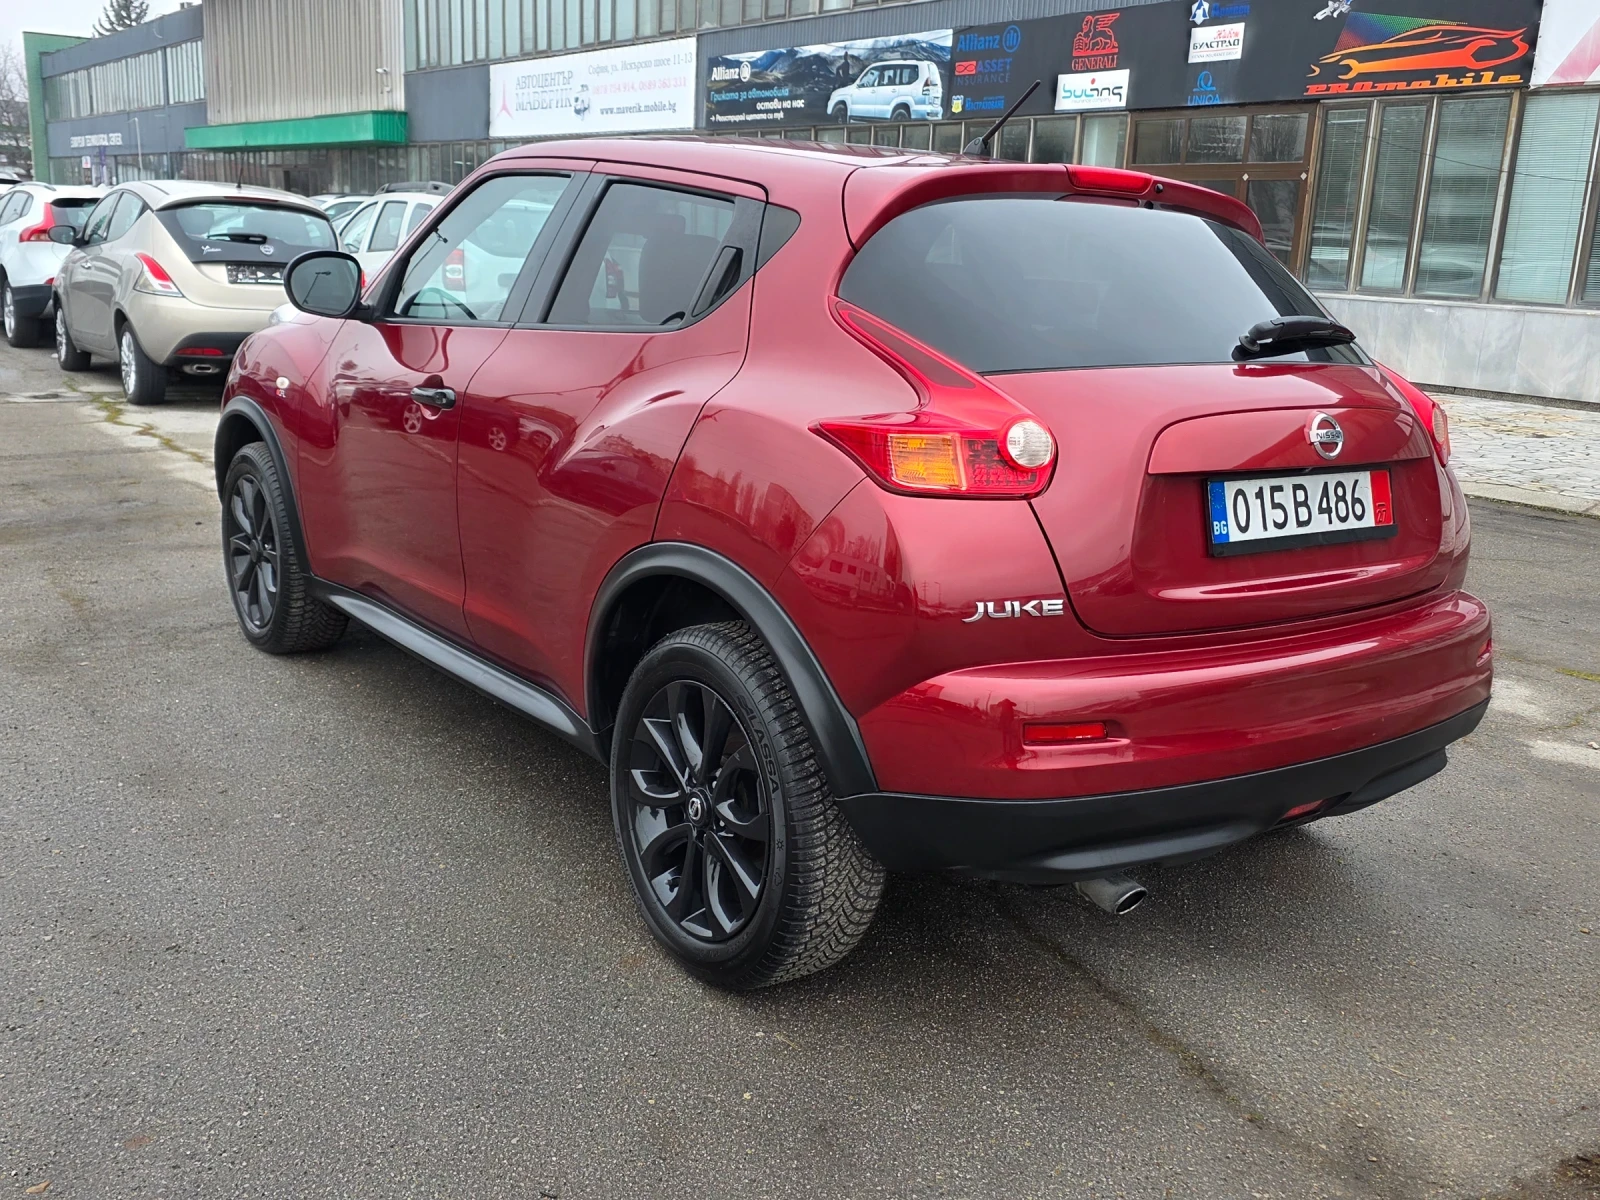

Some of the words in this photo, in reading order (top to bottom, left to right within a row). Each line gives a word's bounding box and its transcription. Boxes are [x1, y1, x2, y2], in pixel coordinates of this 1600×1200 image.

[957, 33, 1000, 52] Allianz
[673, 52, 693, 65] 11-13
[976, 58, 1012, 73] ASSET
[1071, 55, 1118, 72] GENERALI
[515, 70, 573, 91] АВТОЦЕНТЪР
[711, 66, 739, 81] Allianz
[954, 73, 1010, 87] INSURANCE
[515, 88, 573, 111] МАВЕРИК
[740, 91, 747, 102] за
[782, 100, 791, 108] на
[792, 99, 805, 108] нас
[1187, 93, 1220, 106] UNIQA
[600, 100, 677, 115] www.maverik.mobile.bg
[1213, 520, 1228, 536] BG
[961, 599, 1064, 624] JUKE
[747, 713, 780, 795] LASSA
